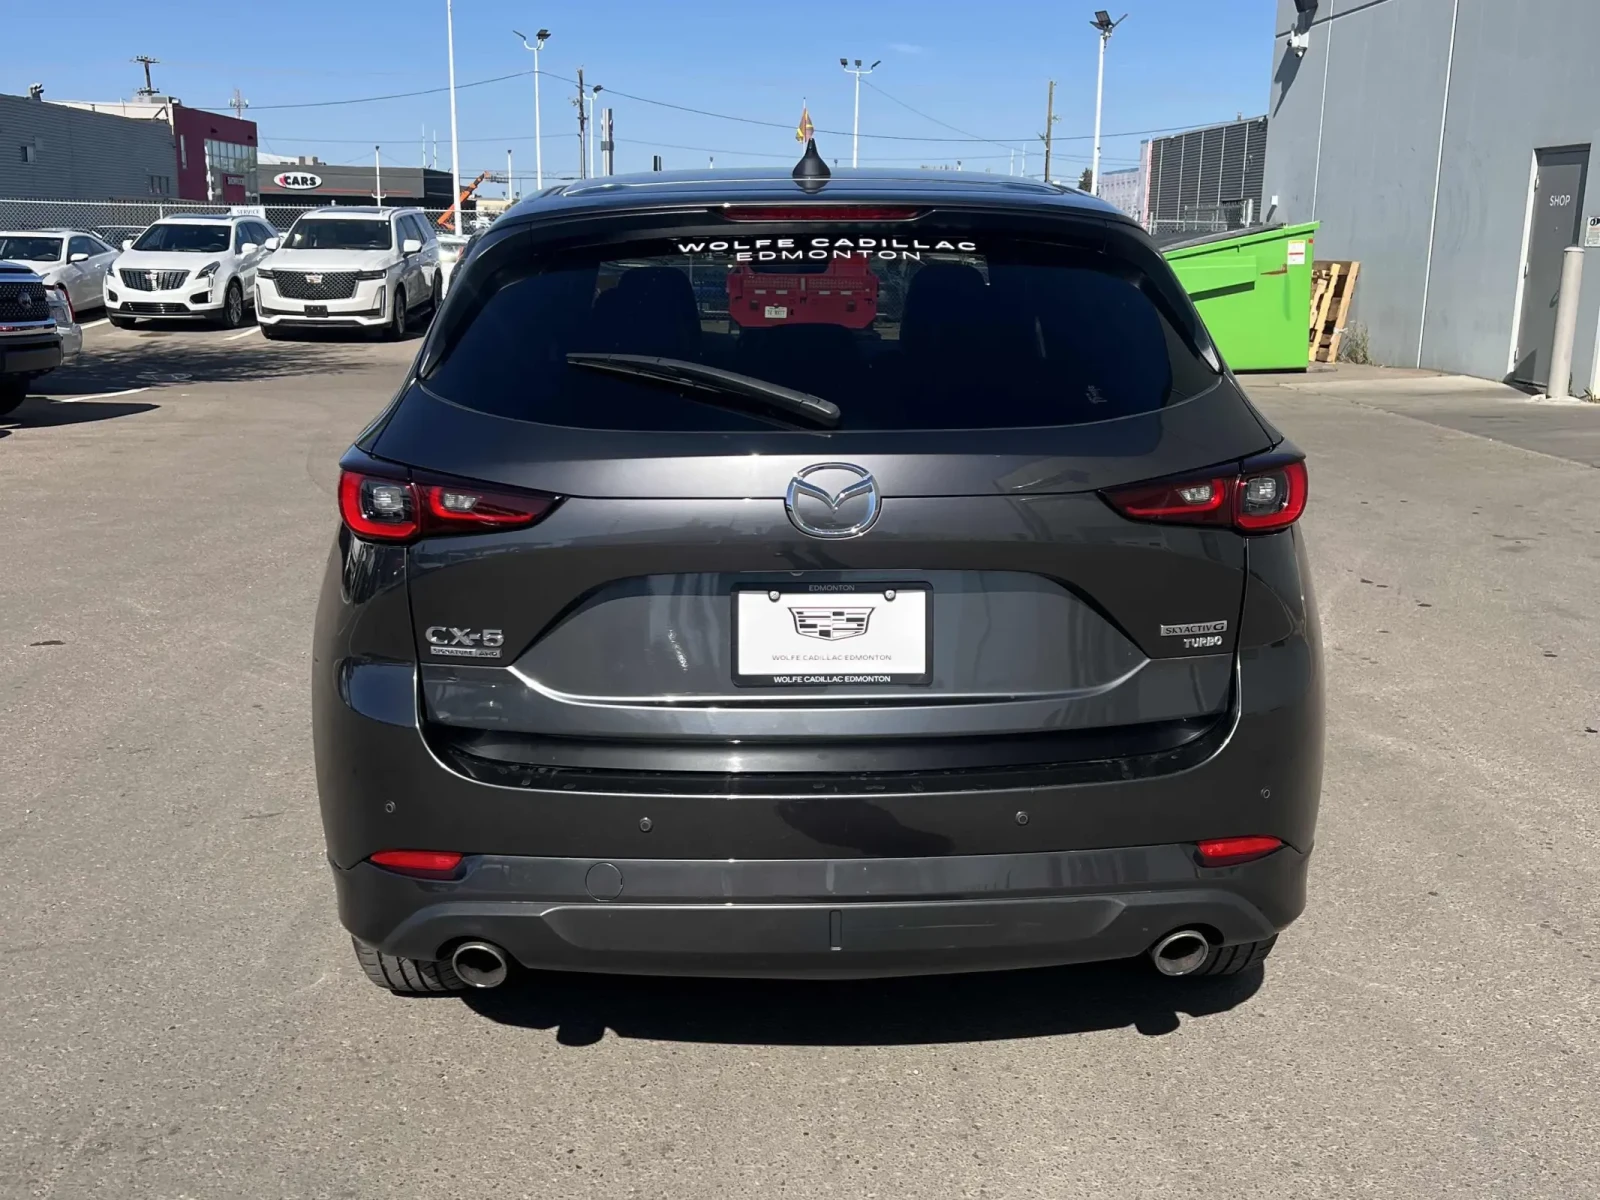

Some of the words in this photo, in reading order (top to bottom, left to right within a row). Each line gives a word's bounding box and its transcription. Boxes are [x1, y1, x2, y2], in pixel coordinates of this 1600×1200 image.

[284, 175, 317, 186] CARS
[1549, 194, 1571, 207] SHOP
[677, 238, 795, 253] WOLFE
[811, 238, 977, 252] CADILLAC
[736, 249, 921, 262] EDMONTON
[808, 584, 855, 592] EDMONTON
[425, 626, 505, 647] CX-5
[1183, 635, 1223, 648] TURBO
[773, 675, 803, 683] WOLFE
[803, 675, 844, 683] CADILLAC
[844, 675, 891, 683] EDMONTON
